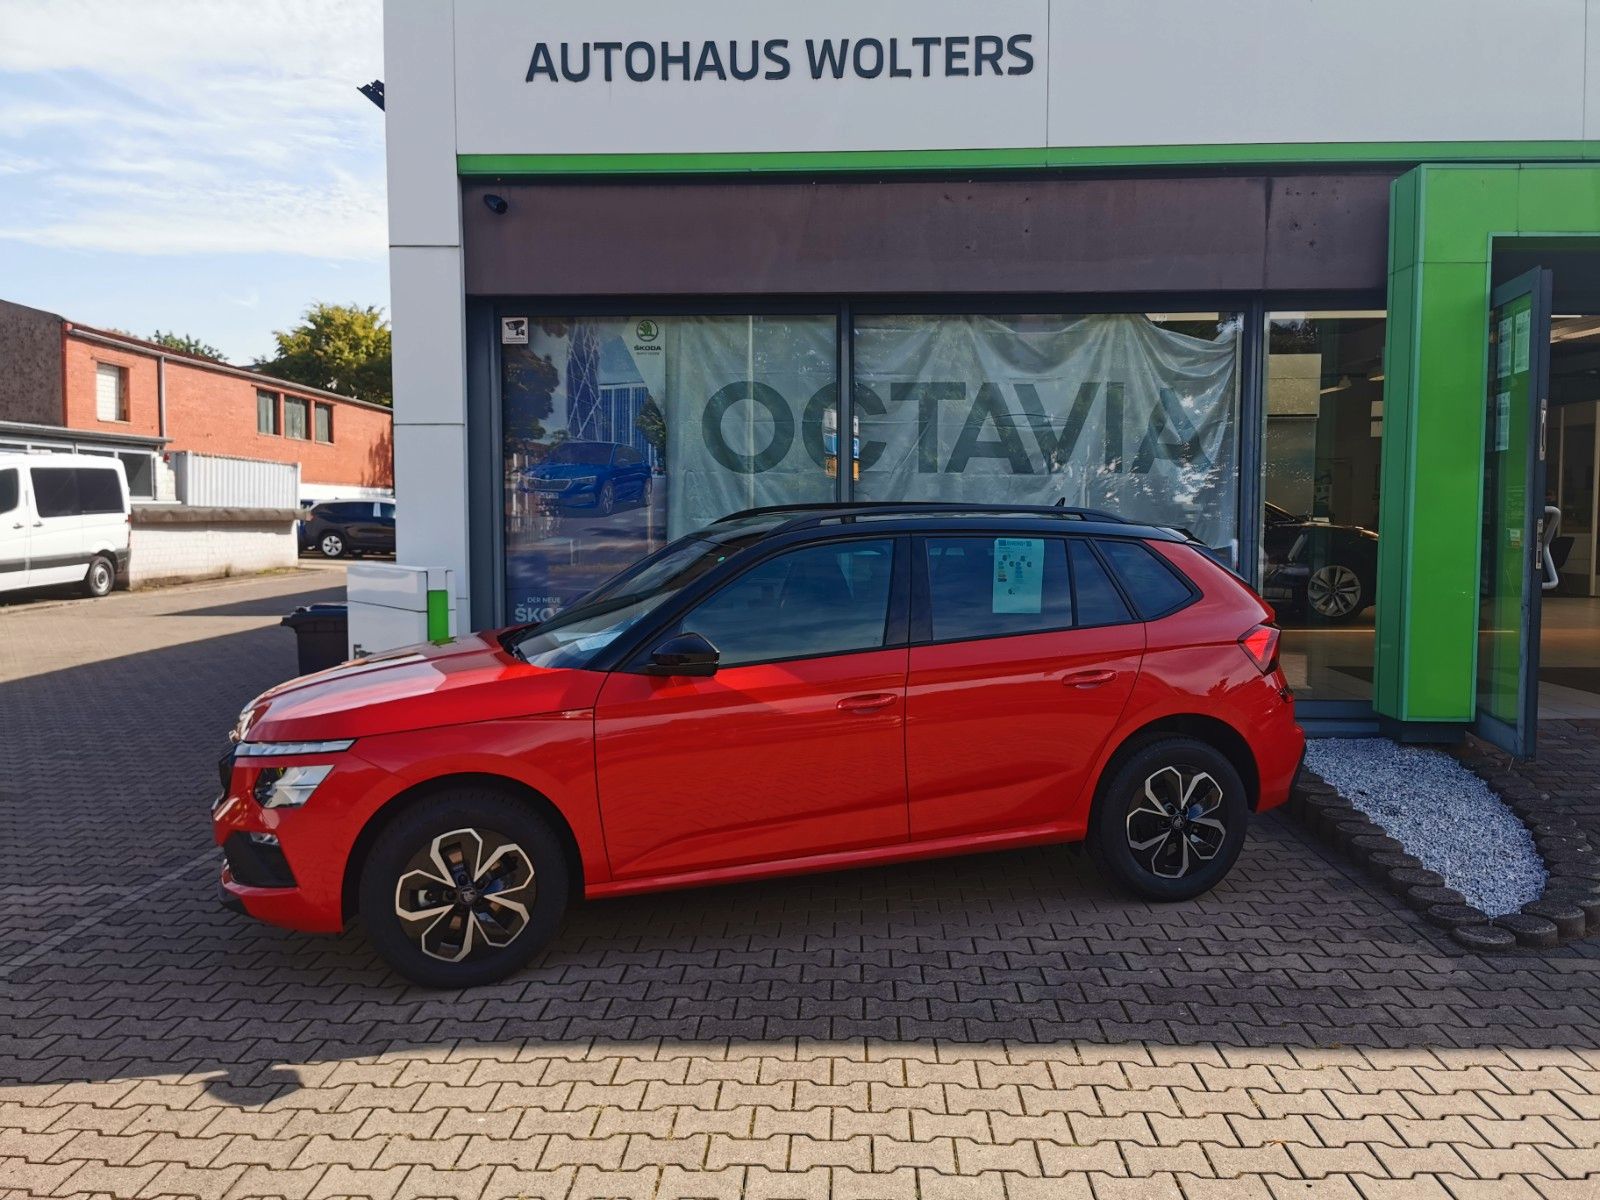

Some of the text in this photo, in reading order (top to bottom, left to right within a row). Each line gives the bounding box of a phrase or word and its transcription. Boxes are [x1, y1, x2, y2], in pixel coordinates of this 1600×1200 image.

[525, 33, 1034, 83] AUTOHAUS WOLTERS
[701, 380, 1213, 475] OCTAVIA
[527, 596, 561, 604] DER NEUE
